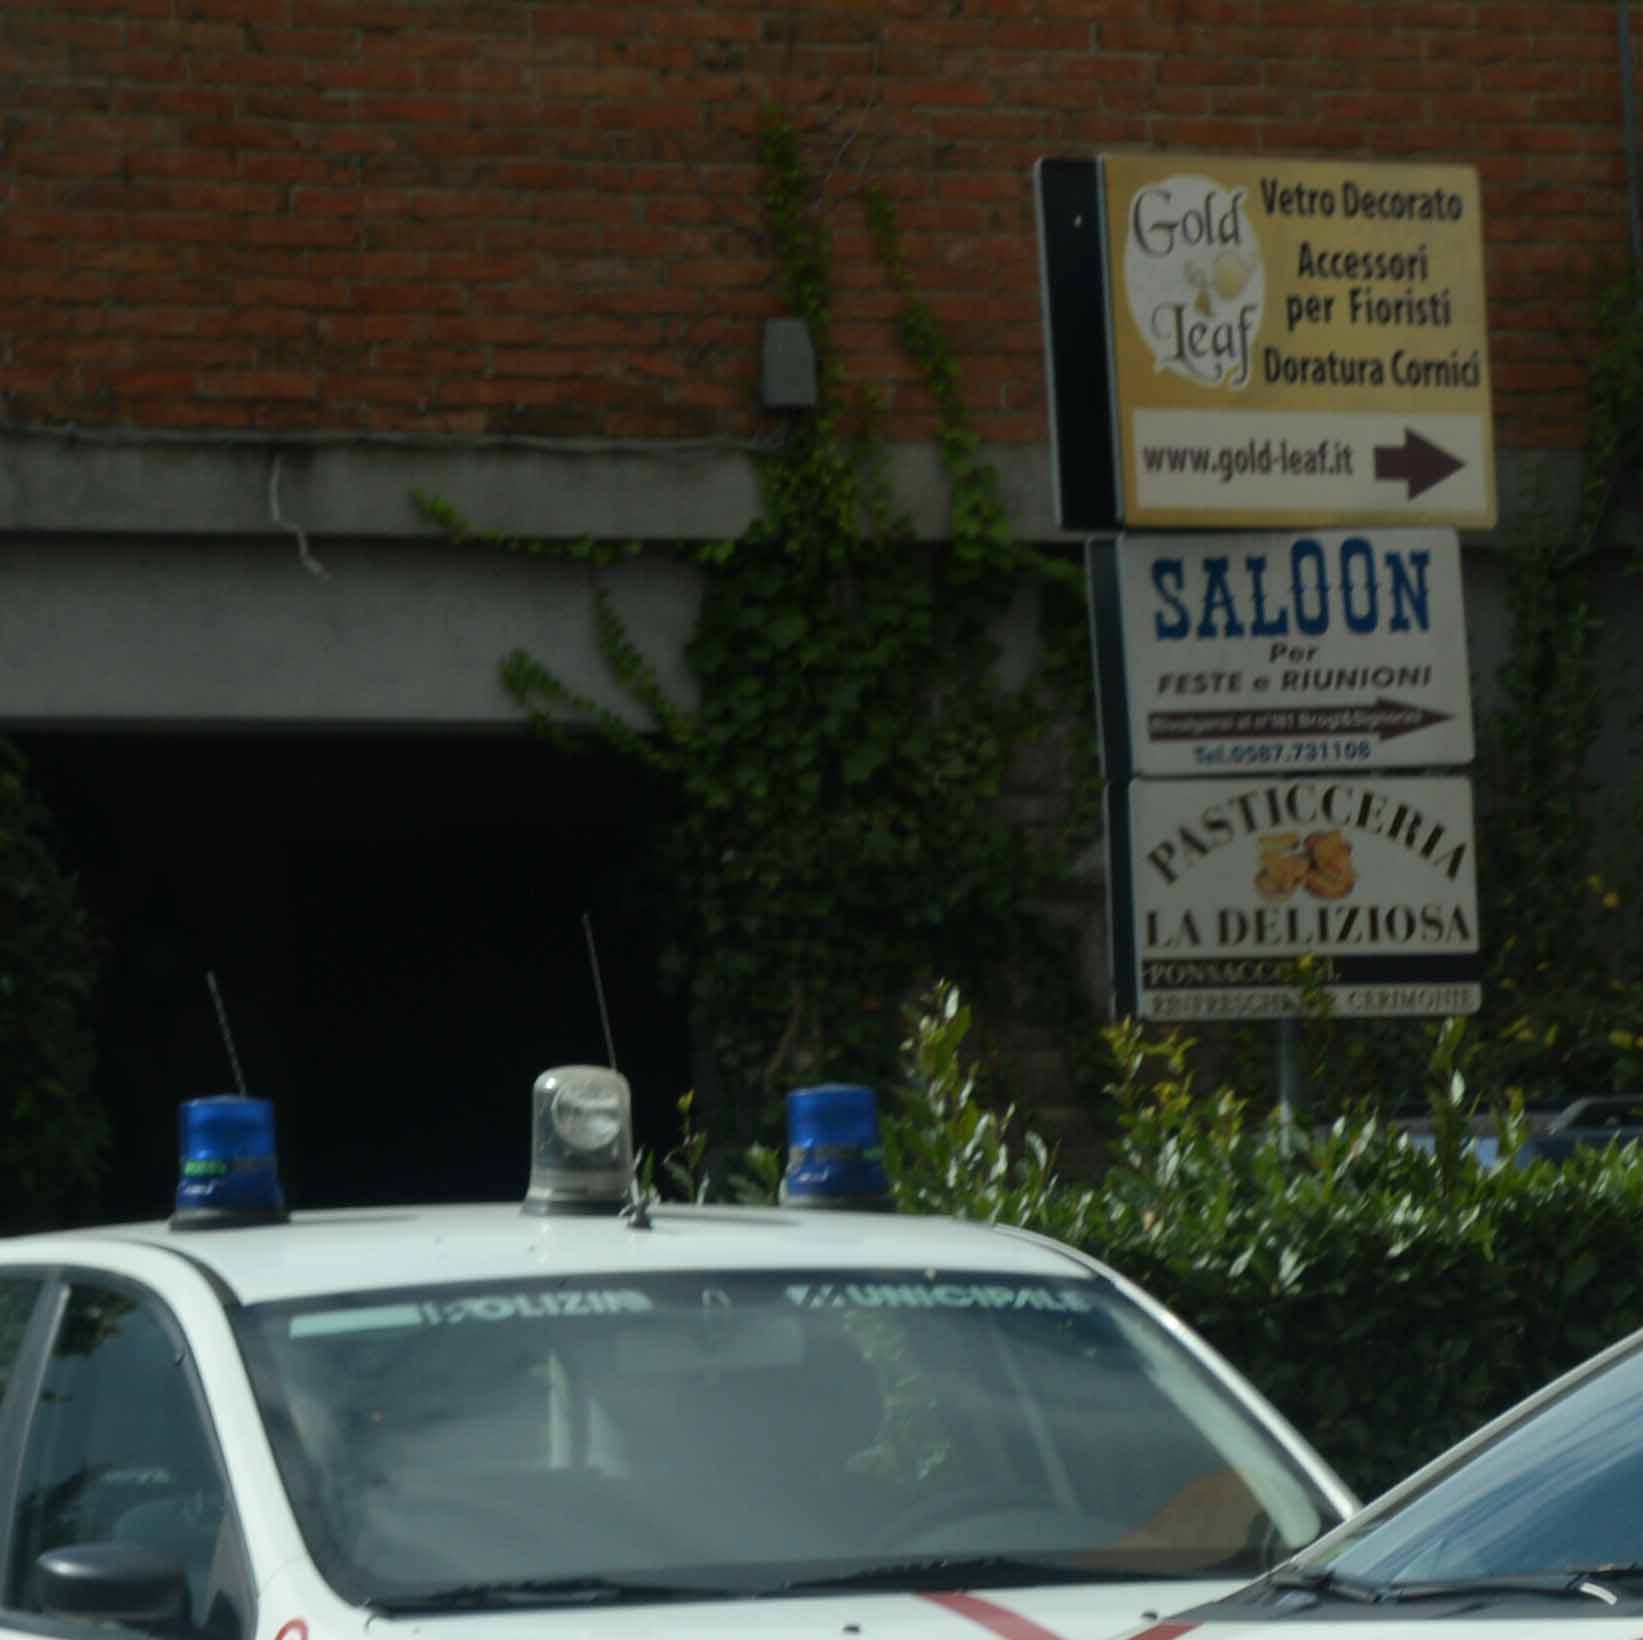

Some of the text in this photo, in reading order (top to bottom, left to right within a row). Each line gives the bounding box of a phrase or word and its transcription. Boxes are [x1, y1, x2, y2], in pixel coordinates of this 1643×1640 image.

[1261, 178, 1463, 222] Vetro Decorato
[1133, 189, 1247, 257] Gold
[1297, 243, 1428, 280] Accessori
[1286, 289, 1452, 330] per Fioristi
[1152, 301, 1258, 385] Leaf
[1263, 348, 1481, 388] Doratura Cornici
[1142, 439, 1354, 481] www.gold-leaf.it
[1150, 537, 1431, 640] SALOON
[1268, 642, 1319, 664] Per
[1157, 671, 1242, 695] FESTE
[1281, 667, 1432, 692] RIUNIONI
[1146, 782, 1468, 885] PASTICCERIA
[1146, 903, 1472, 948] LA DELIZIOSA
